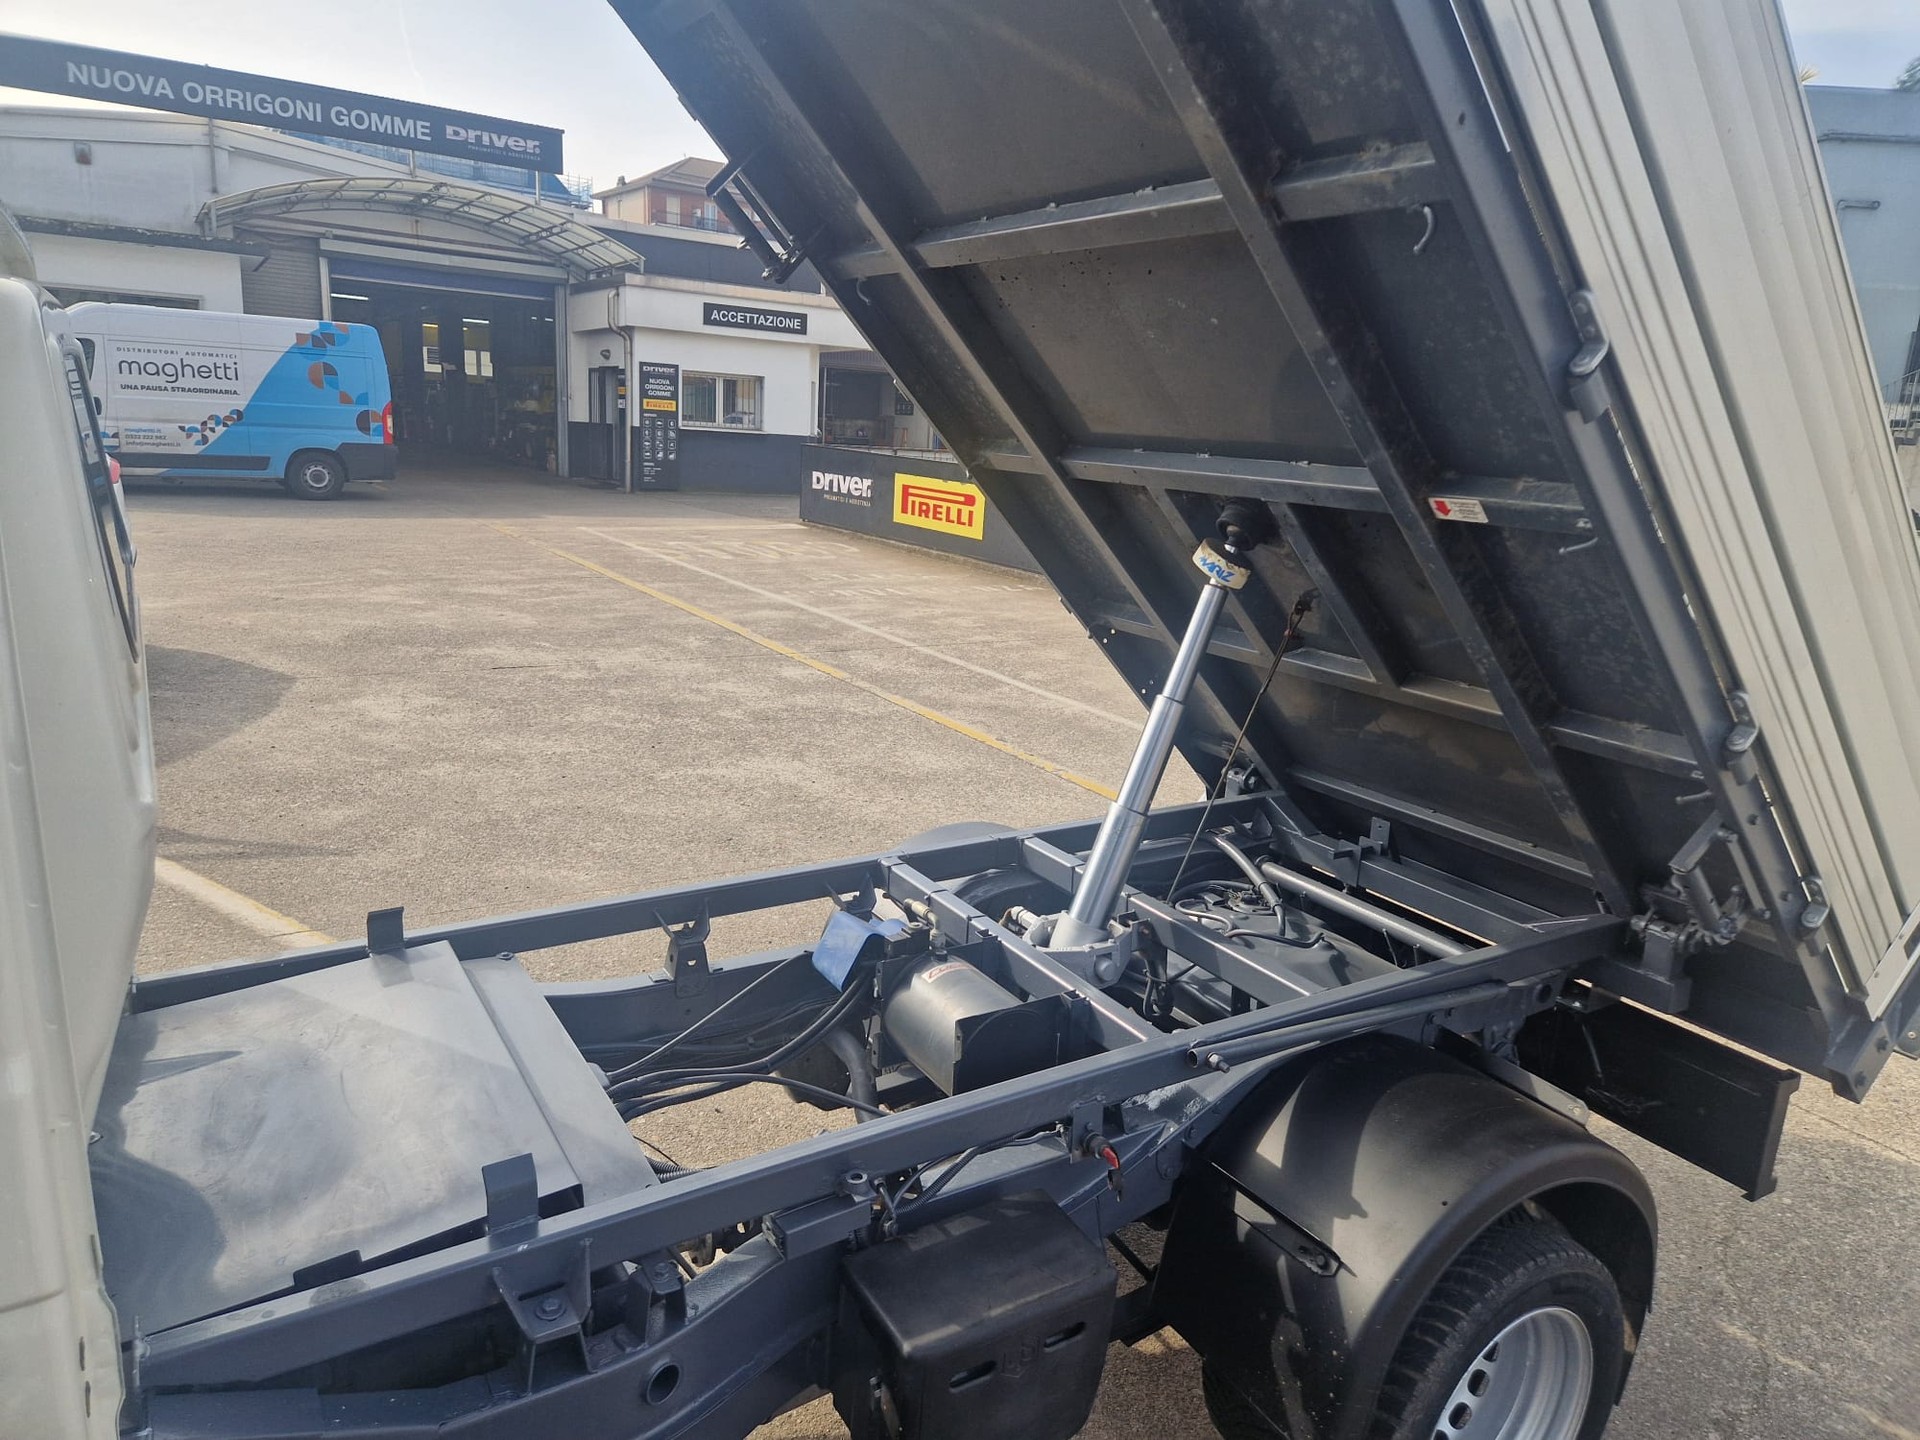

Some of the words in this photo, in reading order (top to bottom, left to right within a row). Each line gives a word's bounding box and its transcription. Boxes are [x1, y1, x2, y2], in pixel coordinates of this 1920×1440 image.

[66, 61, 175, 100] NUOVA
[182, 82, 322, 123] ORRIGONI
[330, 105, 432, 141] GOMME
[711, 309, 801, 329] ACCETTAZIONE
[116, 346, 179, 355] DISTRIBUTORI
[185, 351, 237, 359] AUTOMATICI
[118, 358, 239, 383] maghetti
[648, 390, 672, 398] GOMME
[901, 484, 977, 528] PIRELLI
